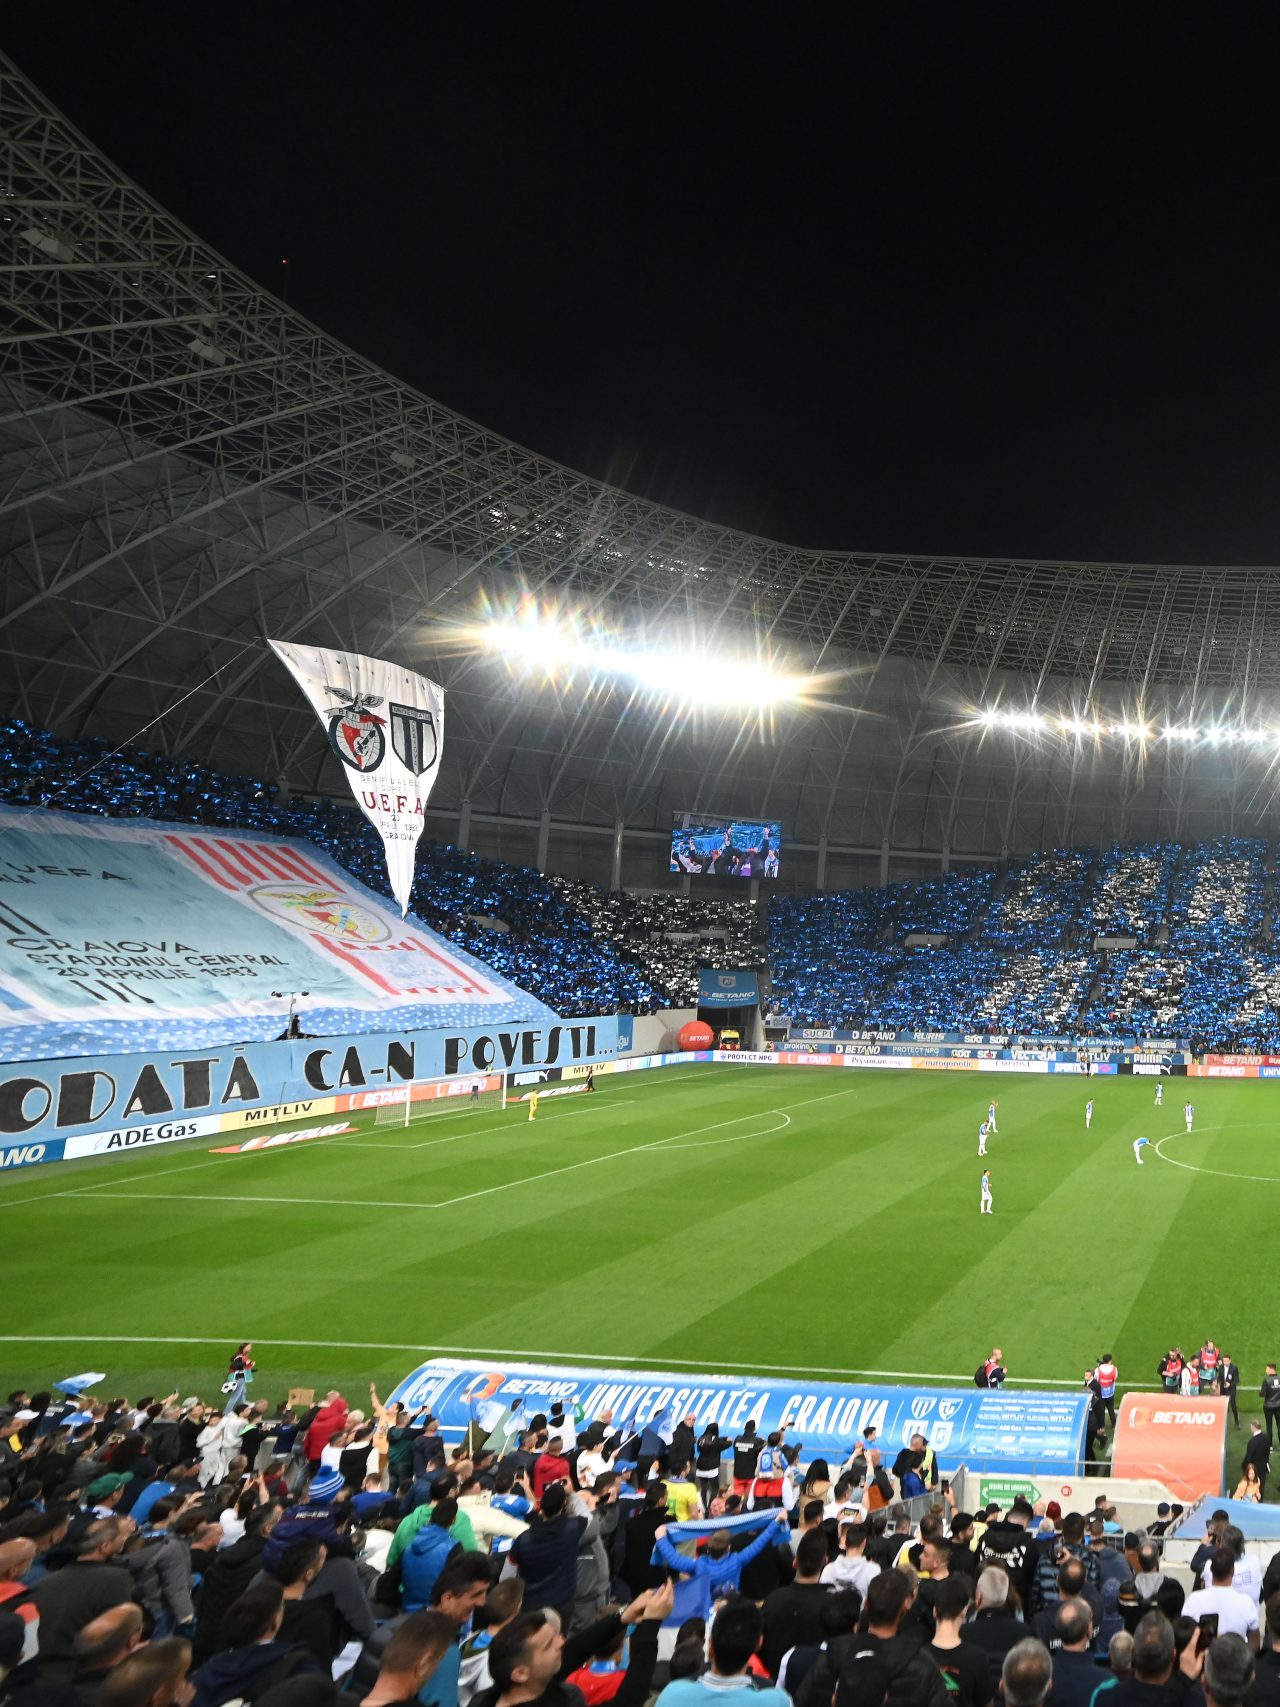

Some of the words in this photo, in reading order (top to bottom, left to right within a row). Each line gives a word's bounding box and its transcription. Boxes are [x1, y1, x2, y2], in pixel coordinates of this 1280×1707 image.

[6, 938, 198, 953] CRAIOVA
[26, 953, 180, 967] STADIONUL
[184, 954, 289, 966] CENTRAL
[48, 966, 90, 977] 20
[94, 967, 196, 980] APRILIE
[200, 967, 259, 977] 1983
[711, 991, 755, 999] BETANO
[845, 1045, 880, 1054] BETANO
[893, 1046, 924, 1054] PROTECT
[797, 1055, 831, 1065] BETANO
[1134, 1053, 1162, 1063] PUMA
[1223, 1055, 1262, 1065] BETANO
[305, 1042, 415, 1091] CA-N
[573, 1063, 605, 1075] MITLIV
[1133, 1064, 1161, 1075] PUMA
[1208, 1066, 1246, 1076] BETANO
[362, 1089, 409, 1107] BETANO
[244, 1102, 314, 1122] MITLIV
[500, 1379, 579, 1396] BETANO
[583, 1383, 770, 1430] UNIVERSITATEA
[778, 1394, 890, 1439] CRAIOVA
[1152, 1411, 1216, 1426] BETANO
